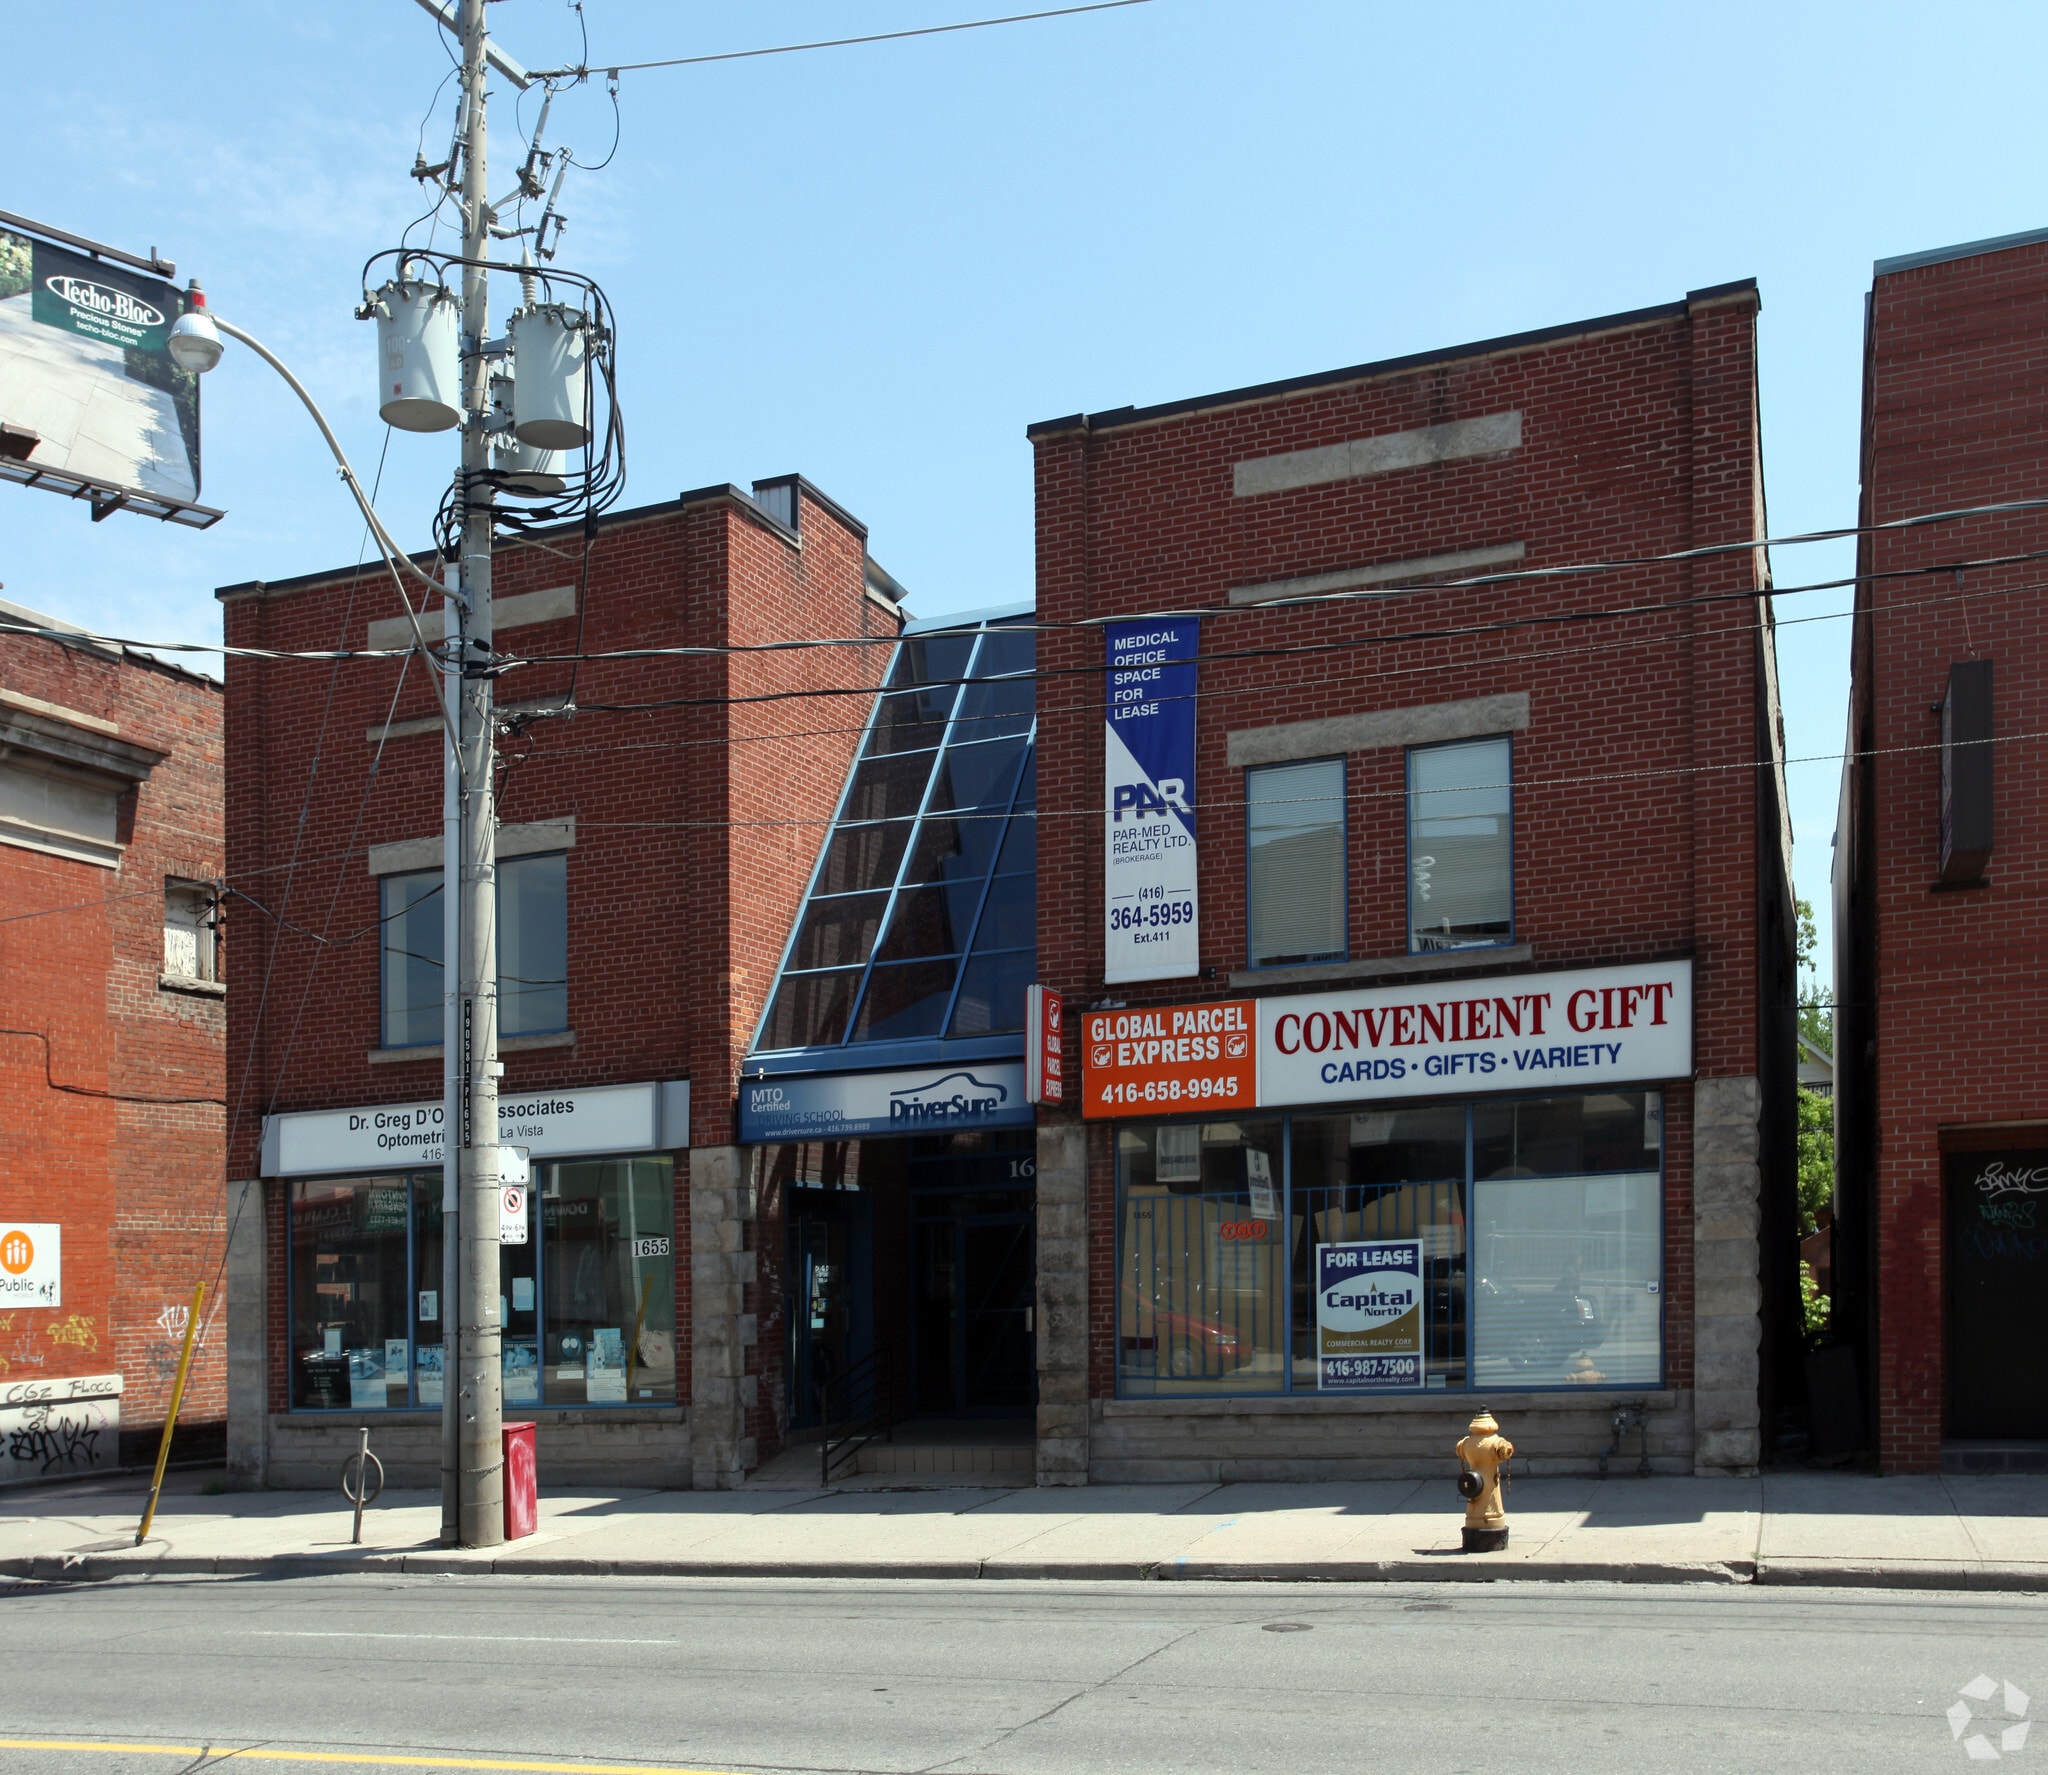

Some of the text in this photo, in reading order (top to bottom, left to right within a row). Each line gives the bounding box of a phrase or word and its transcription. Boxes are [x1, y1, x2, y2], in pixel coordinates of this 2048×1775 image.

[60, 277, 152, 323] Techo-Bloc
[70, 307, 110, 327] Precious
[76, 321, 138, 346] techo-bloc.com
[1114, 631, 1179, 650] MEDICAL
[1114, 650, 1166, 667] OFFICE
[1114, 668, 1161, 685] SPACE
[1114, 688, 1144, 702] FOR
[1114, 703, 1159, 720] LEASE
[1113, 824, 1171, 841] PAR-MED
[1113, 835, 1191, 854] REALTY LTD.
[1113, 852, 1163, 865] (BROKERAGE)
[1138, 885, 1165, 901] (416)
[1110, 901, 1193, 930] 364-5959
[1133, 931, 1171, 945] Ext.411
[1091, 1006, 1248, 1042] GLOBAL PARCEL
[1274, 982, 1673, 1056] CONVENIENT GIFT
[1047, 1034, 1061, 1053] GLOBAL
[1117, 1036, 1221, 1067] EXPRESS
[1047, 1056, 1061, 1076] PARCEL
[1321, 1042, 1622, 1085] CARDS GIFTS VARIETY
[751, 1088, 783, 1104] MTO
[1045, 1078, 1062, 1099] EXPRESS
[1101, 1076, 1239, 1105] 416-658-9945
[349, 1100, 575, 1131] Dr. Greg D'O ssociates
[751, 1100, 791, 1113] Certified
[890, 1094, 998, 1122] DriverSure
[758, 1109, 846, 1127] DRIVING SCHOOL
[377, 1123, 544, 1151] Optometri La Vista
[765, 1122, 870, 1137] www.driversure.ca 416.739.8989
[421, 1148, 444, 1161] 416-
[1009, 1157, 1035, 1179] 16
[1221, 1221, 1265, 1239] TNT
[634, 1239, 669, 1256] 1655
[1326, 1249, 1413, 1268] FOR LEASE
[0, 1278, 35, 1292] Public
[1326, 1289, 1413, 1311] Capital
[1365, 1307, 1402, 1317] North
[1327, 1340, 1368, 1348] COMMERCIAL
[1394, 1338, 1412, 1346] CORP.
[1326, 1359, 1414, 1376] 416-987-7500
[1327, 1376, 1415, 1384] www.capitalnorthrealty.com
